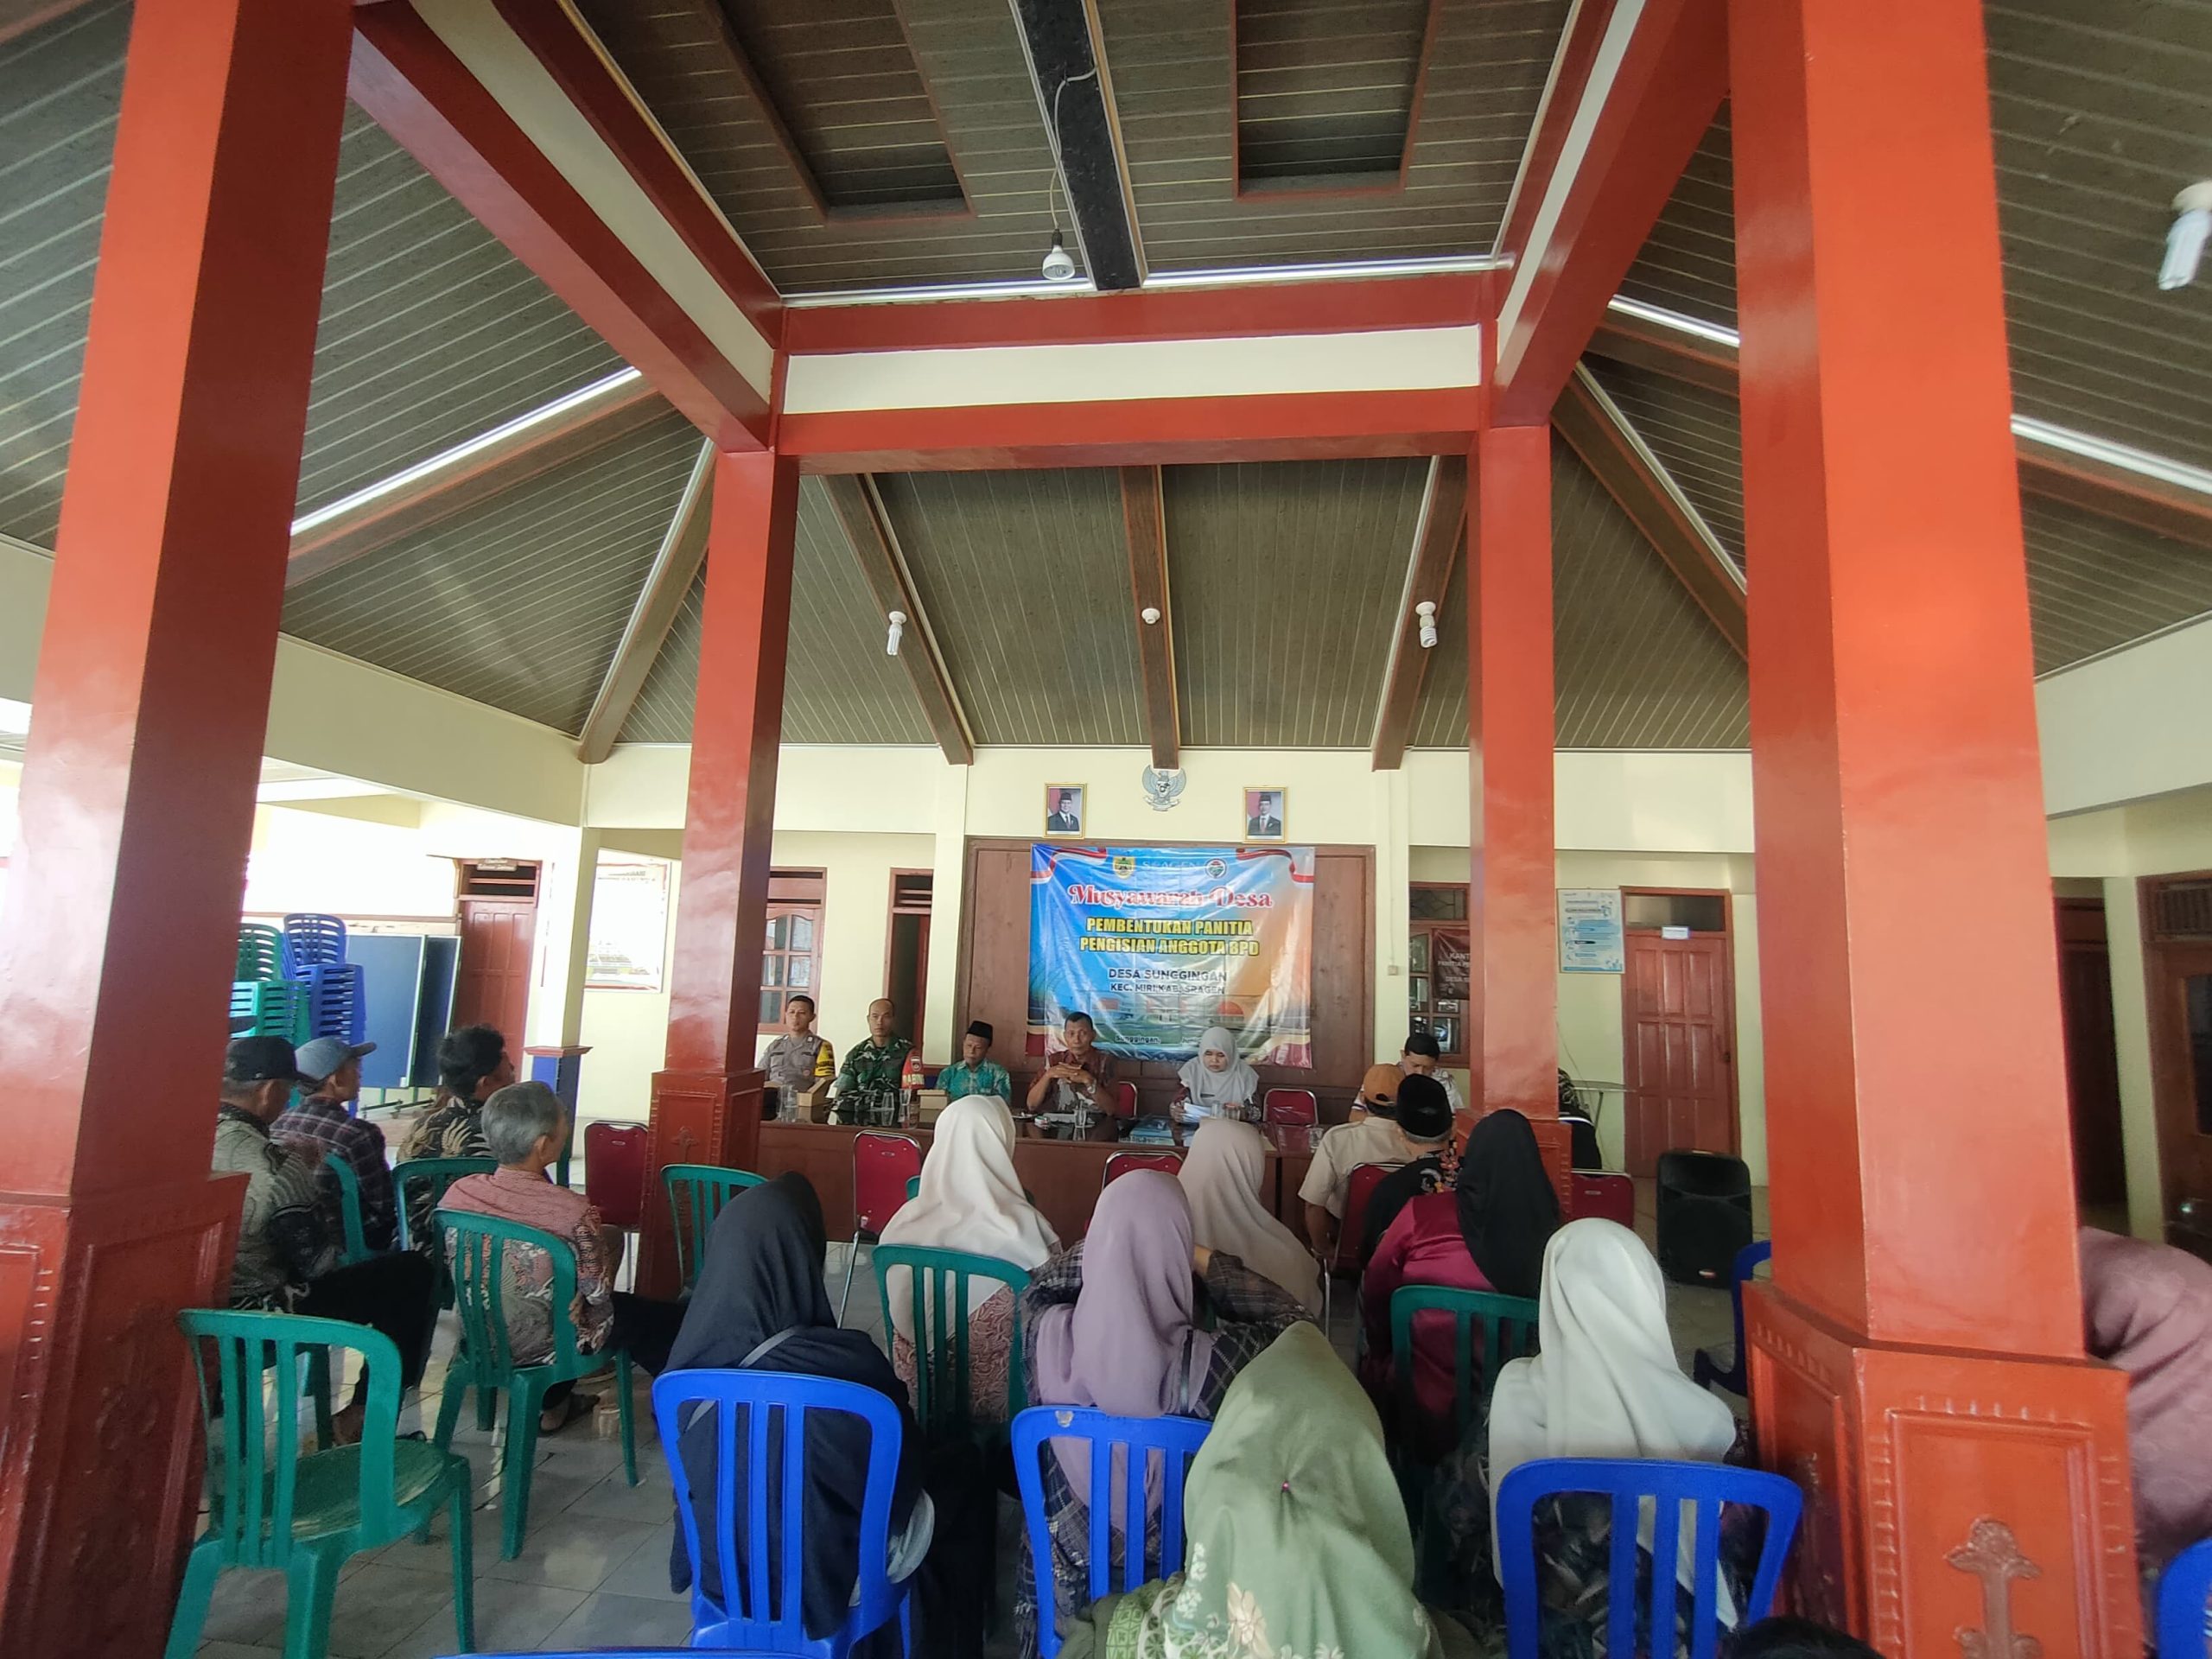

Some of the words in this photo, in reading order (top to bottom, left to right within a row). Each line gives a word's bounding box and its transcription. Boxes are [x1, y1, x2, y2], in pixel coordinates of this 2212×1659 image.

[1210, 886, 1273, 907] Desa
[1086, 917, 1192, 934] PEMBENTUKAN
[1195, 920, 1254, 936] PANITIA
[1080, 937, 1155, 953] PENGISIAN
[1159, 939, 1226, 955] ANGGOTA
[1228, 940, 1260, 956] BPD
[1109, 968, 1141, 979] DESA
[1144, 969, 1227, 982] SUNGGINGAN
[1110, 983, 1133, 992] KEC.
